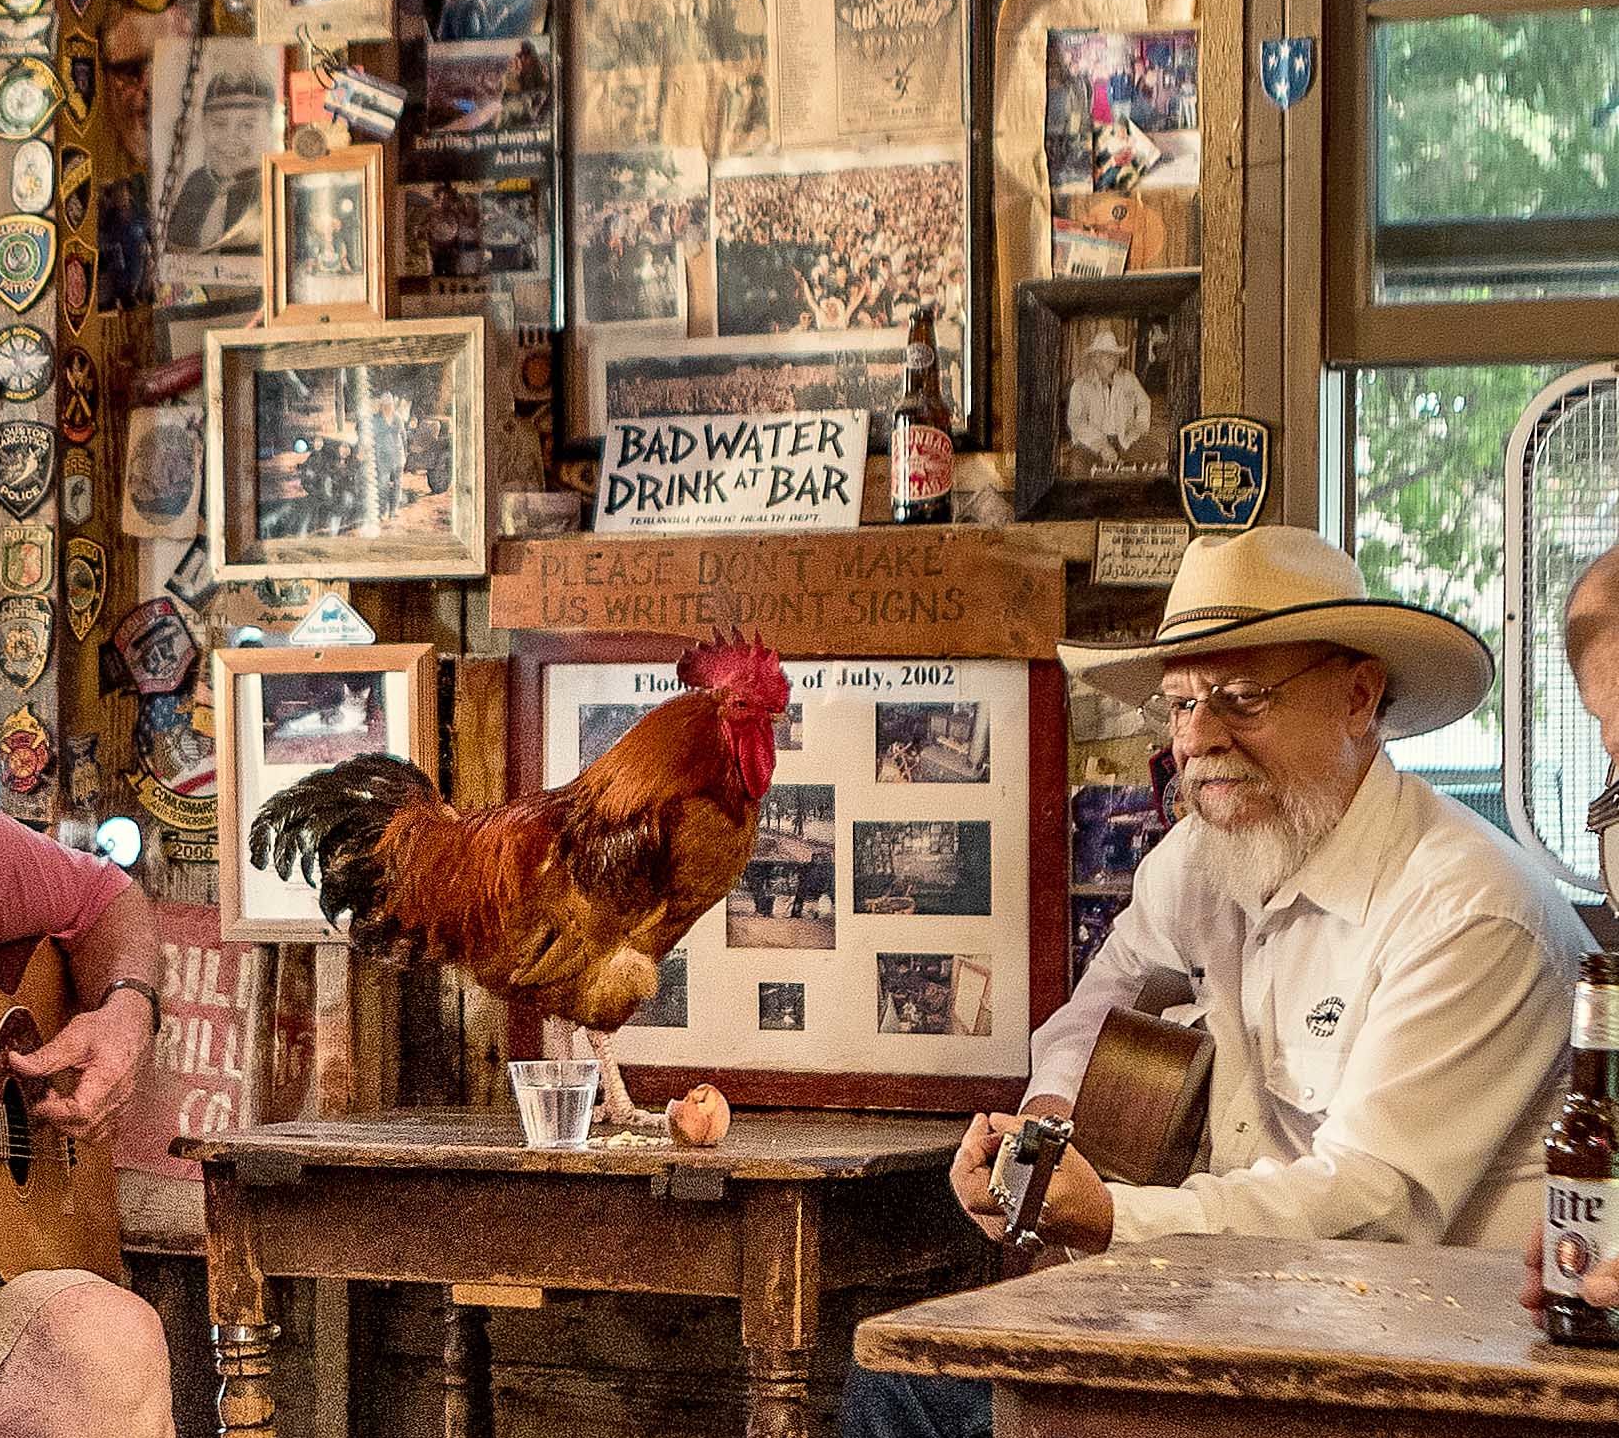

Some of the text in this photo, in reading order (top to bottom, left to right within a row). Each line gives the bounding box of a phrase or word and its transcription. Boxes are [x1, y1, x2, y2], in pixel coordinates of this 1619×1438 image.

[0, 276, 38, 294] PATROL
[1189, 423, 1259, 455] POLICE
[0, 485, 41, 502] POLICE
[603, 464, 851, 515] DRINK AT BAR
[740, 513, 786, 524] HEALTH
[541, 549, 674, 589] PLEASE
[836, 544, 948, 583] MAKE
[543, 592, 590, 626] US
[604, 591, 718, 628] WRITE
[849, 588, 966, 627] SIGNS
[803, 667, 825, 690] of
[835, 666, 893, 693] July,
[899, 665, 955, 687] 2002
[172, 842, 214, 860] 2006
[1547, 1183, 1605, 1229] Lite
